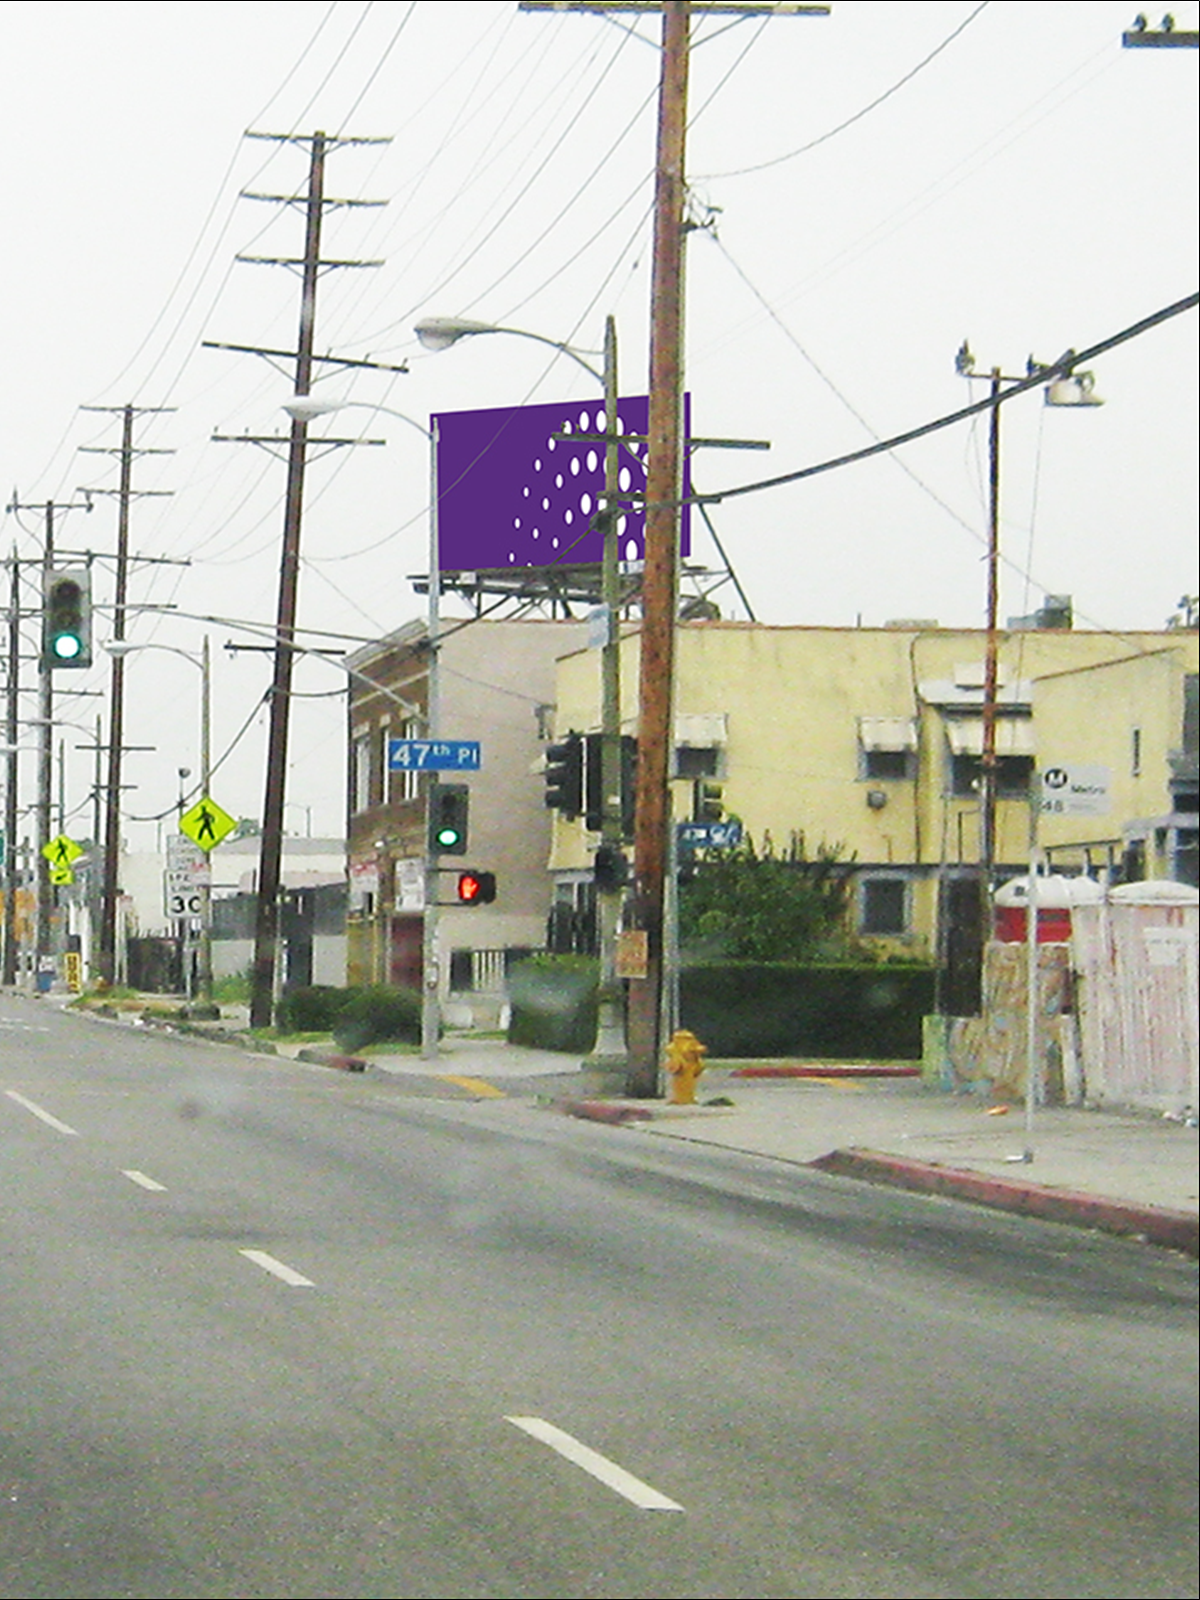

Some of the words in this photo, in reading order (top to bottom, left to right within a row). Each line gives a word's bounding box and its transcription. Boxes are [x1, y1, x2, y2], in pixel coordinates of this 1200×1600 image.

[392, 743, 451, 767] 47th
[458, 747, 477, 764] Pl
[1046, 769, 1065, 788] M
